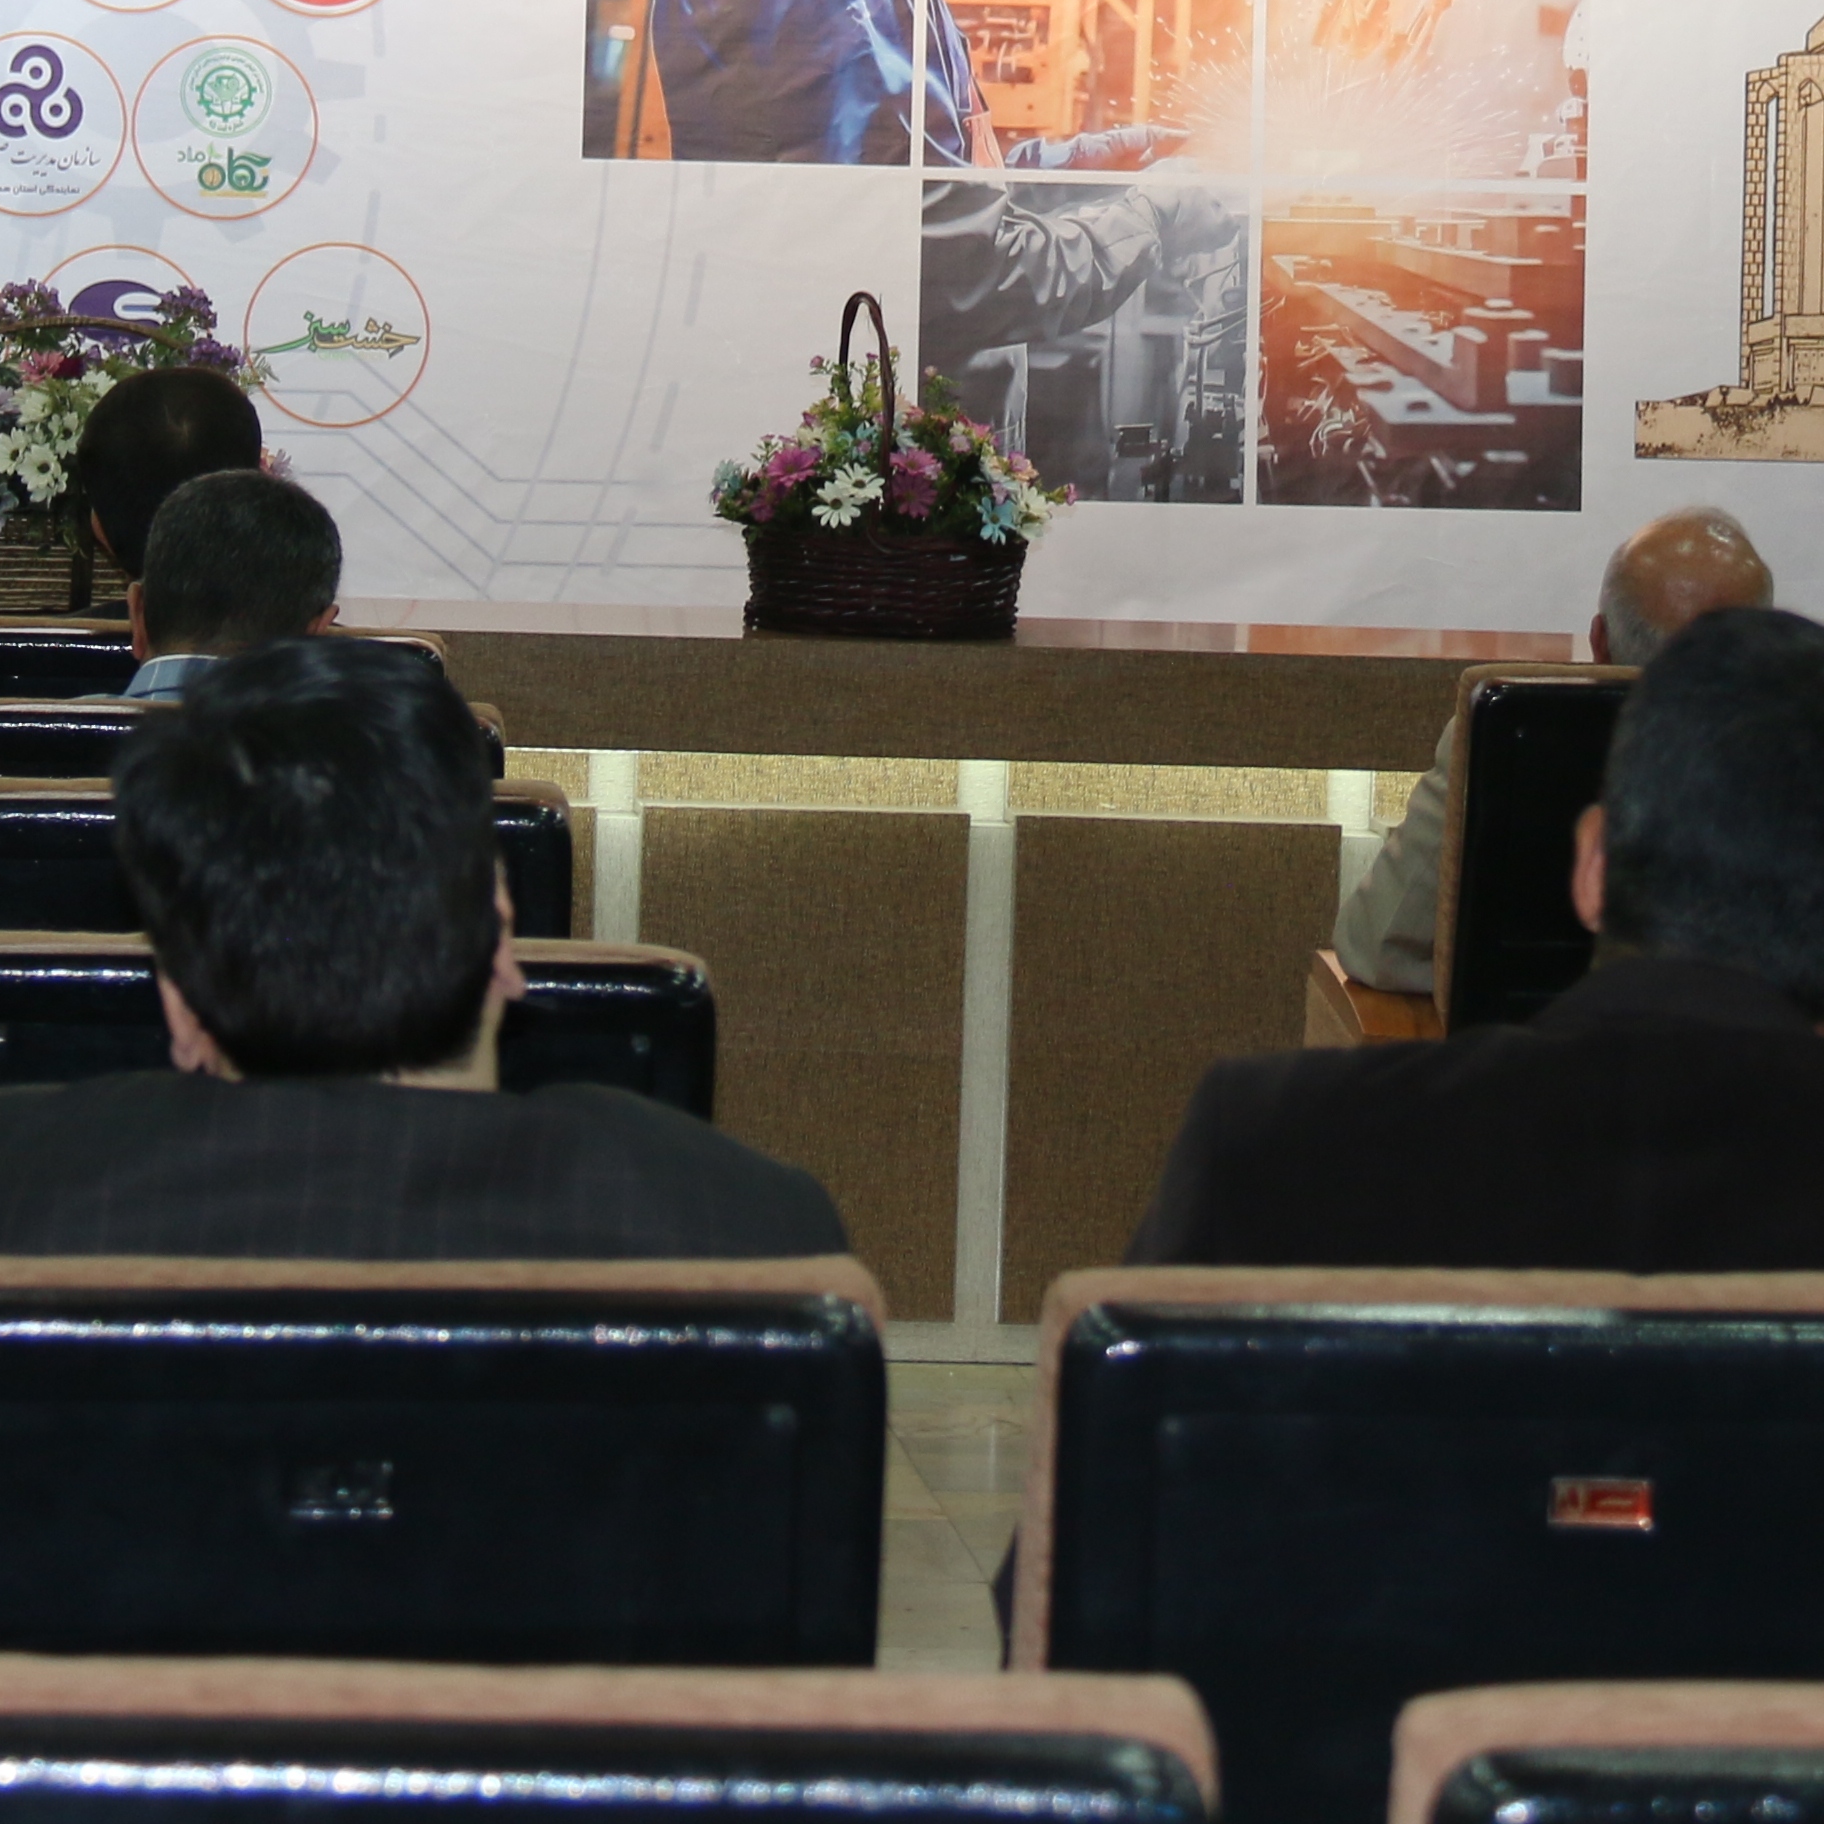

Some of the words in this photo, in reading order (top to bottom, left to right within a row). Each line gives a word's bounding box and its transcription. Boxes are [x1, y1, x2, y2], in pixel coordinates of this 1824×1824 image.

[9, 150, 58, 178] مدیریت
[56, 146, 102, 172] سازمان
[12, 183, 38, 196] استان
